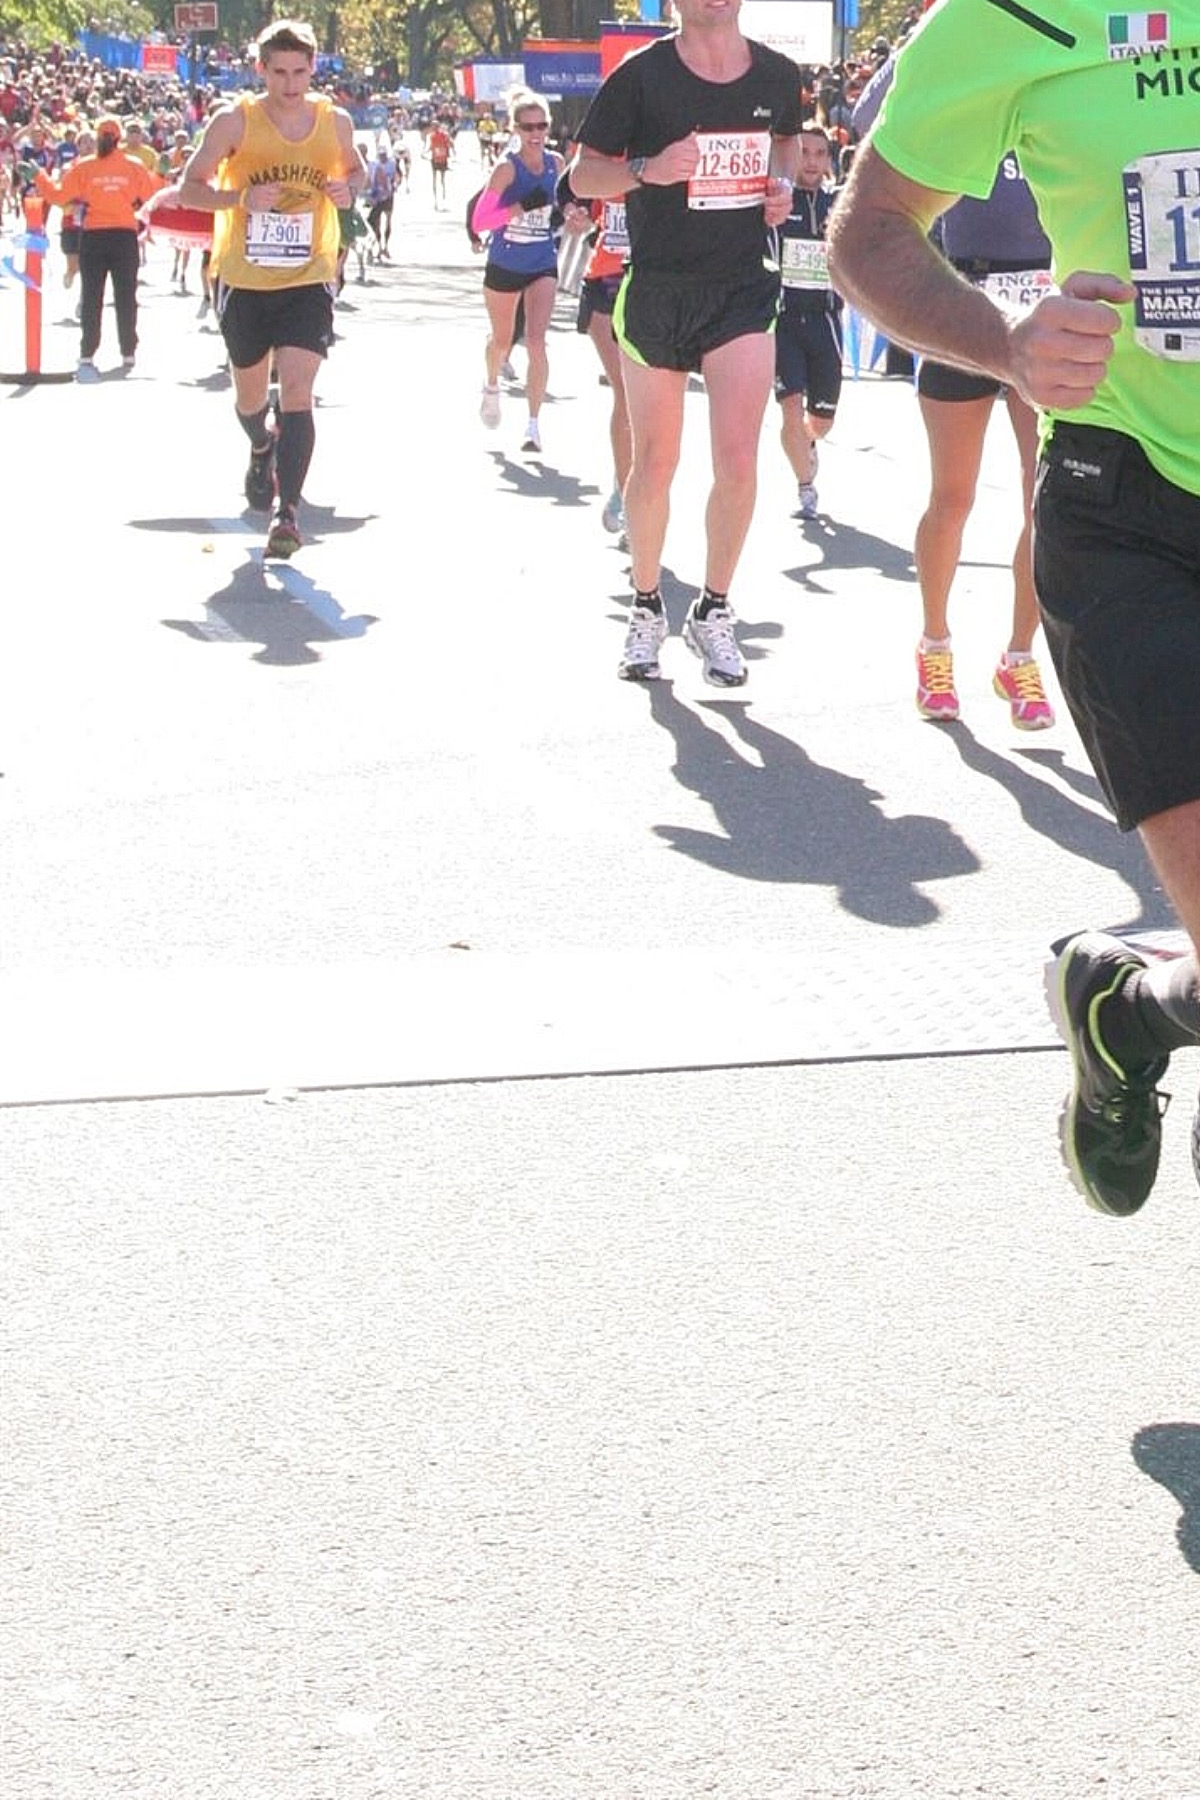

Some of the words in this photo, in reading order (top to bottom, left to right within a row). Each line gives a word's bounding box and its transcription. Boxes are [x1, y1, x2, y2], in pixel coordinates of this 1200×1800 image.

[1110, 44, 1168, 59] ITALIA
[708, 138, 740, 152] ING
[699, 150, 762, 177] 12-686
[248, 163, 326, 190] MARSHFIEL
[261, 224, 300, 242] 7-901
[1129, 199, 1144, 255] WAVE
